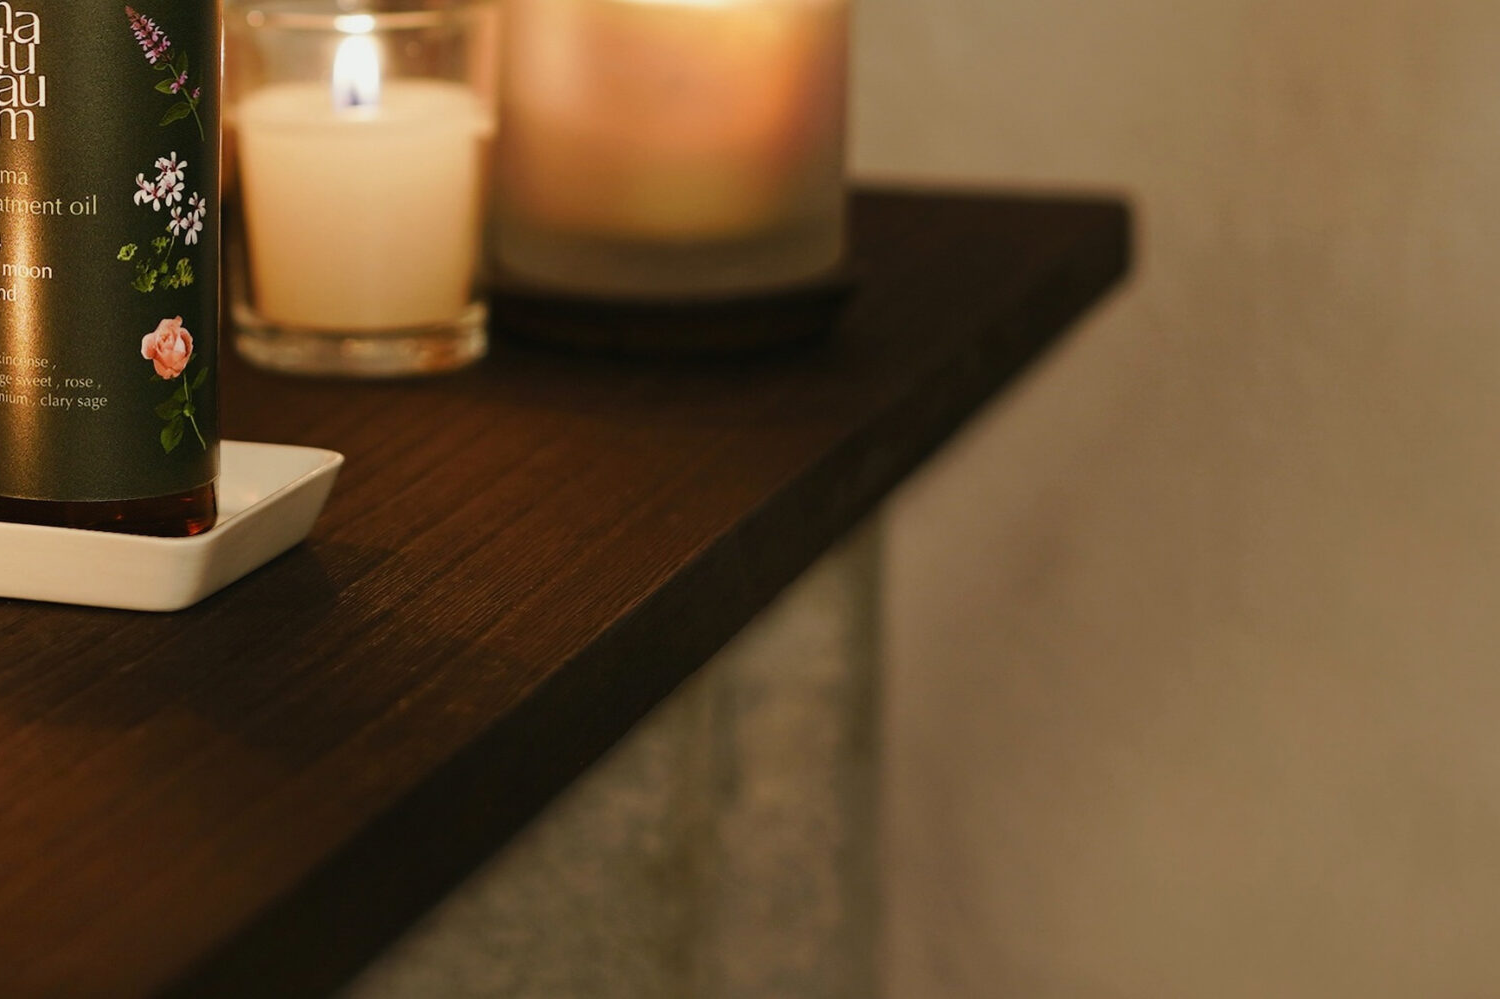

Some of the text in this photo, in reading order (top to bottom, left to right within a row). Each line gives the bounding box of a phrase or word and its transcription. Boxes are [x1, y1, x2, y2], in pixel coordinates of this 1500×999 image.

[69, 194, 98, 216] oil
[2, 262, 53, 280] moon
[15, 376, 52, 388] sweet
[64, 377, 94, 388] rose
[39, 393, 73, 411] clary
[77, 396, 108, 411] sage
